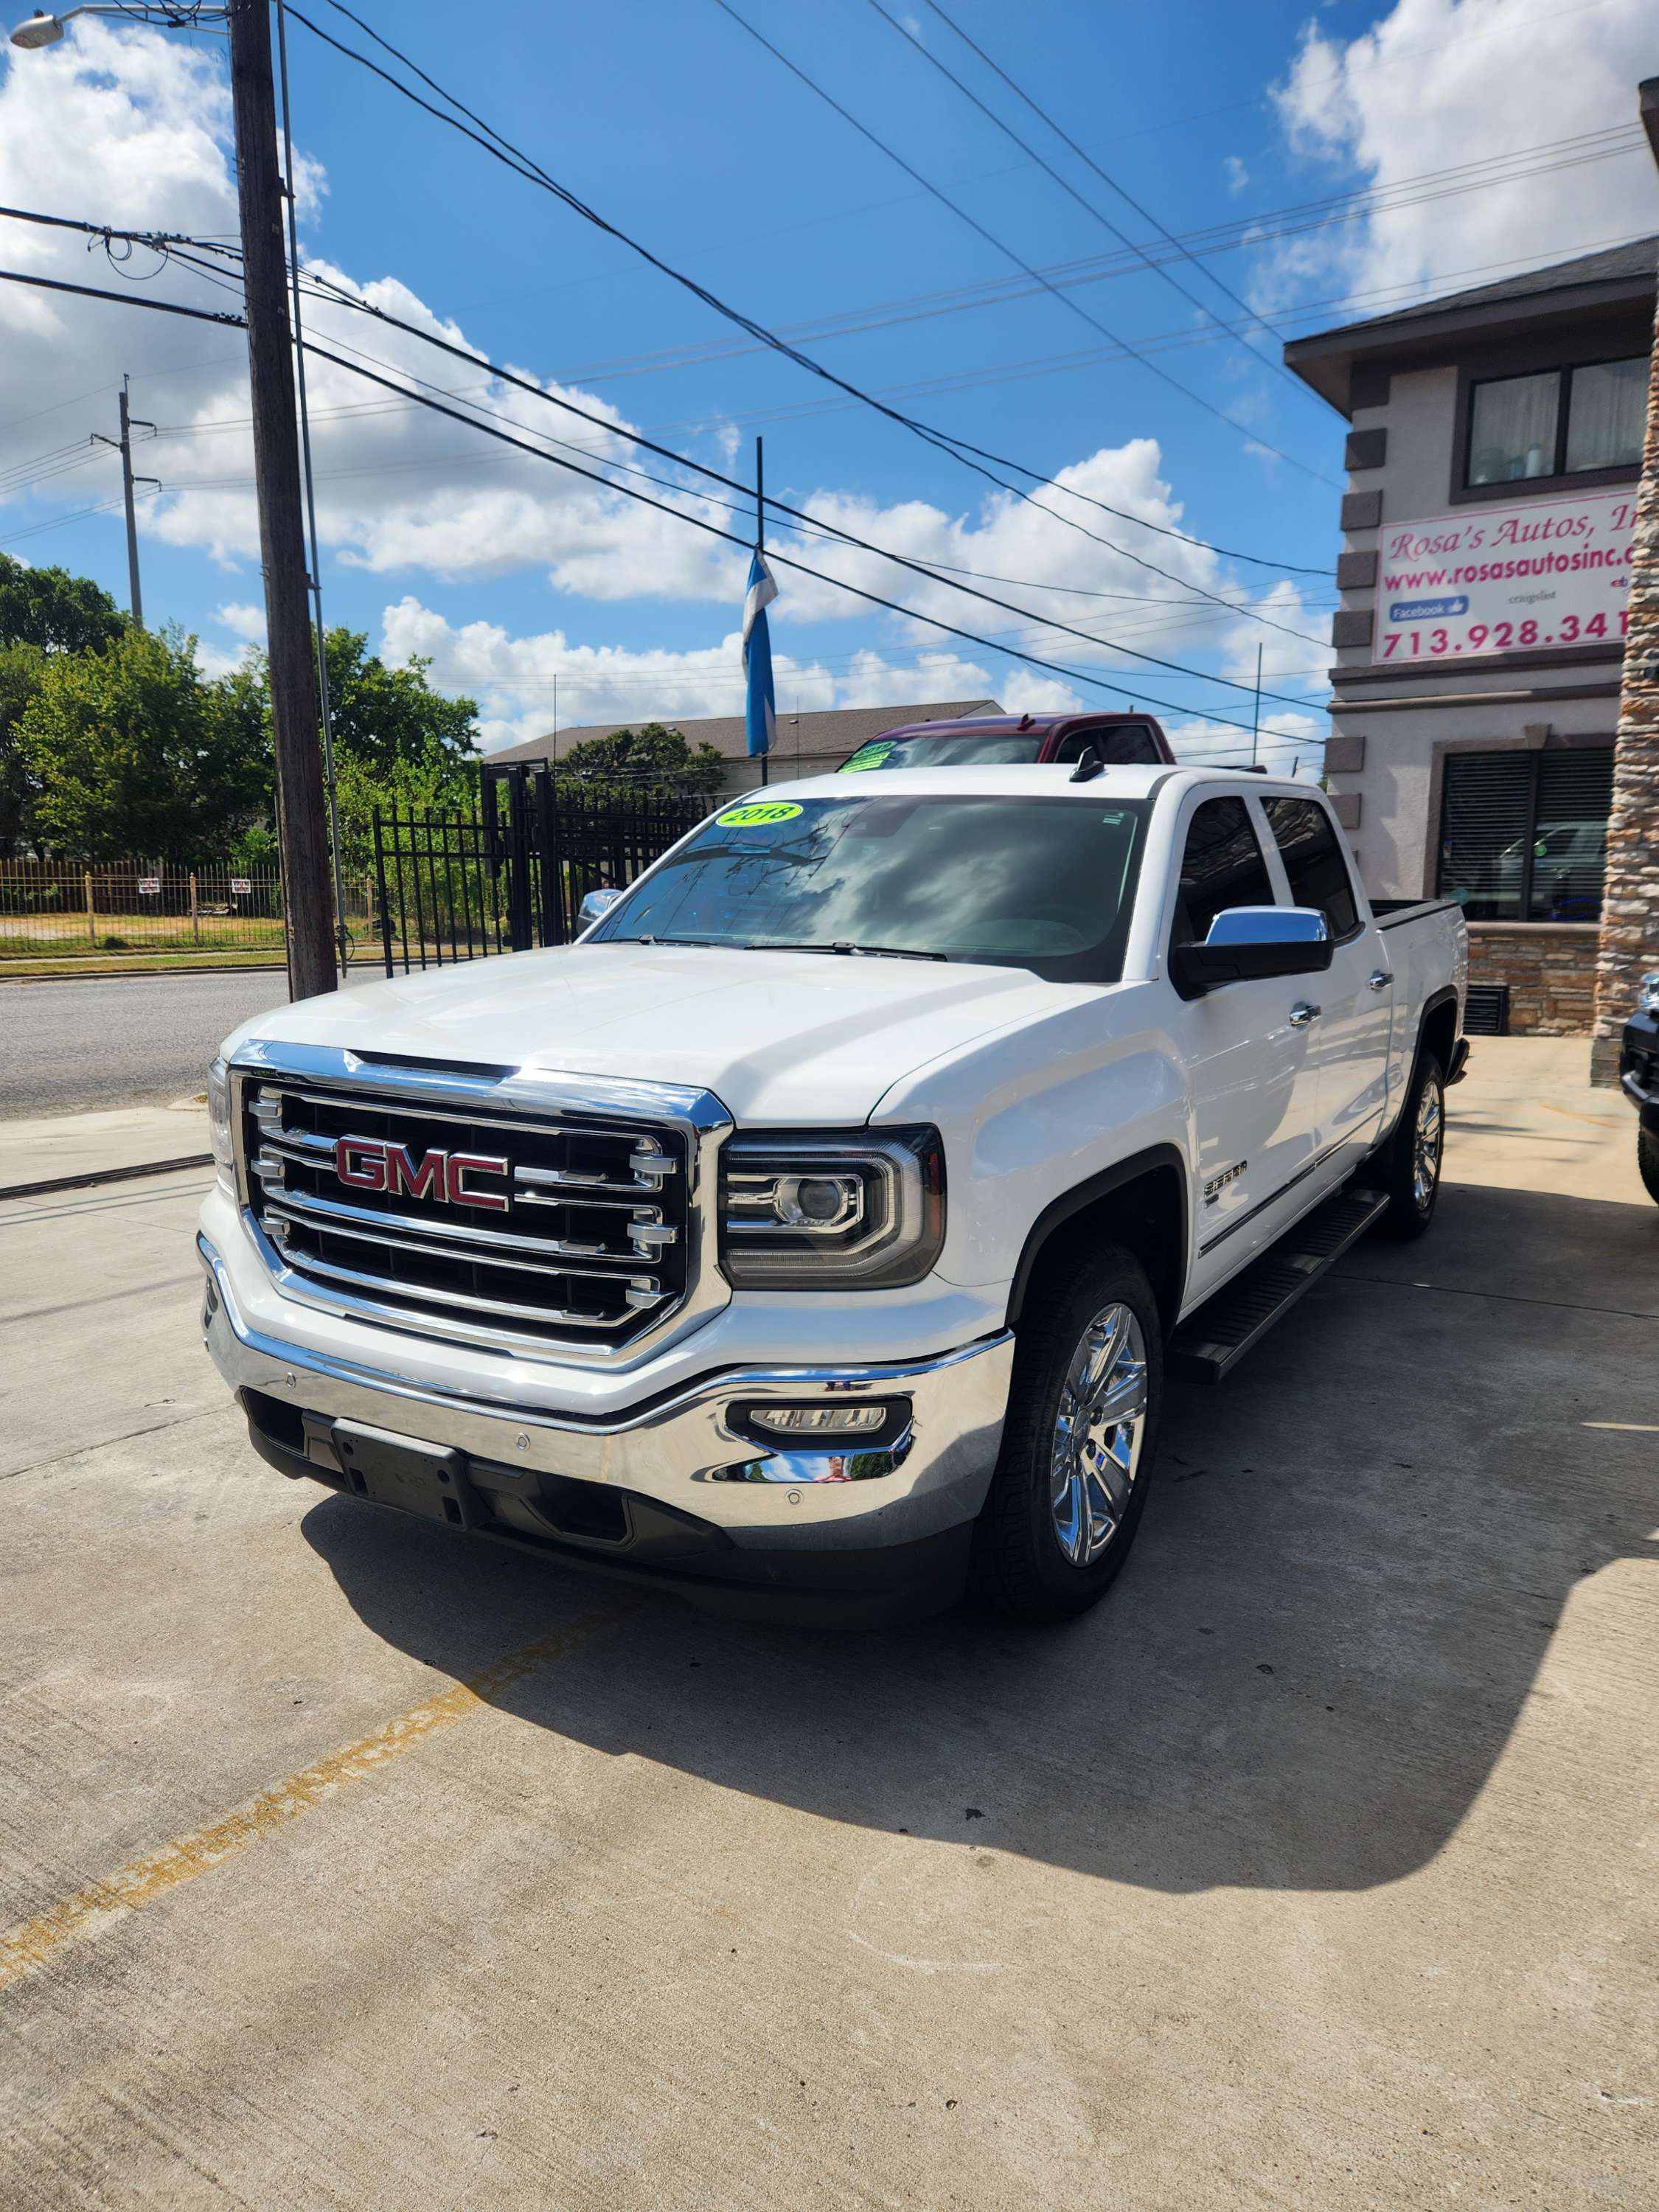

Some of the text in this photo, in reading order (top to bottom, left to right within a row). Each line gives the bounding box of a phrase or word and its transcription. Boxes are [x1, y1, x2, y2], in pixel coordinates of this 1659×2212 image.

[1388, 525, 1485, 562] Rosa's
[1490, 515, 1594, 547] Autos,
[1384, 543, 1635, 591] www.rosasautosinc.c
[723, 807, 796, 823] 2018
[336, 1134, 510, 1213] GMC
